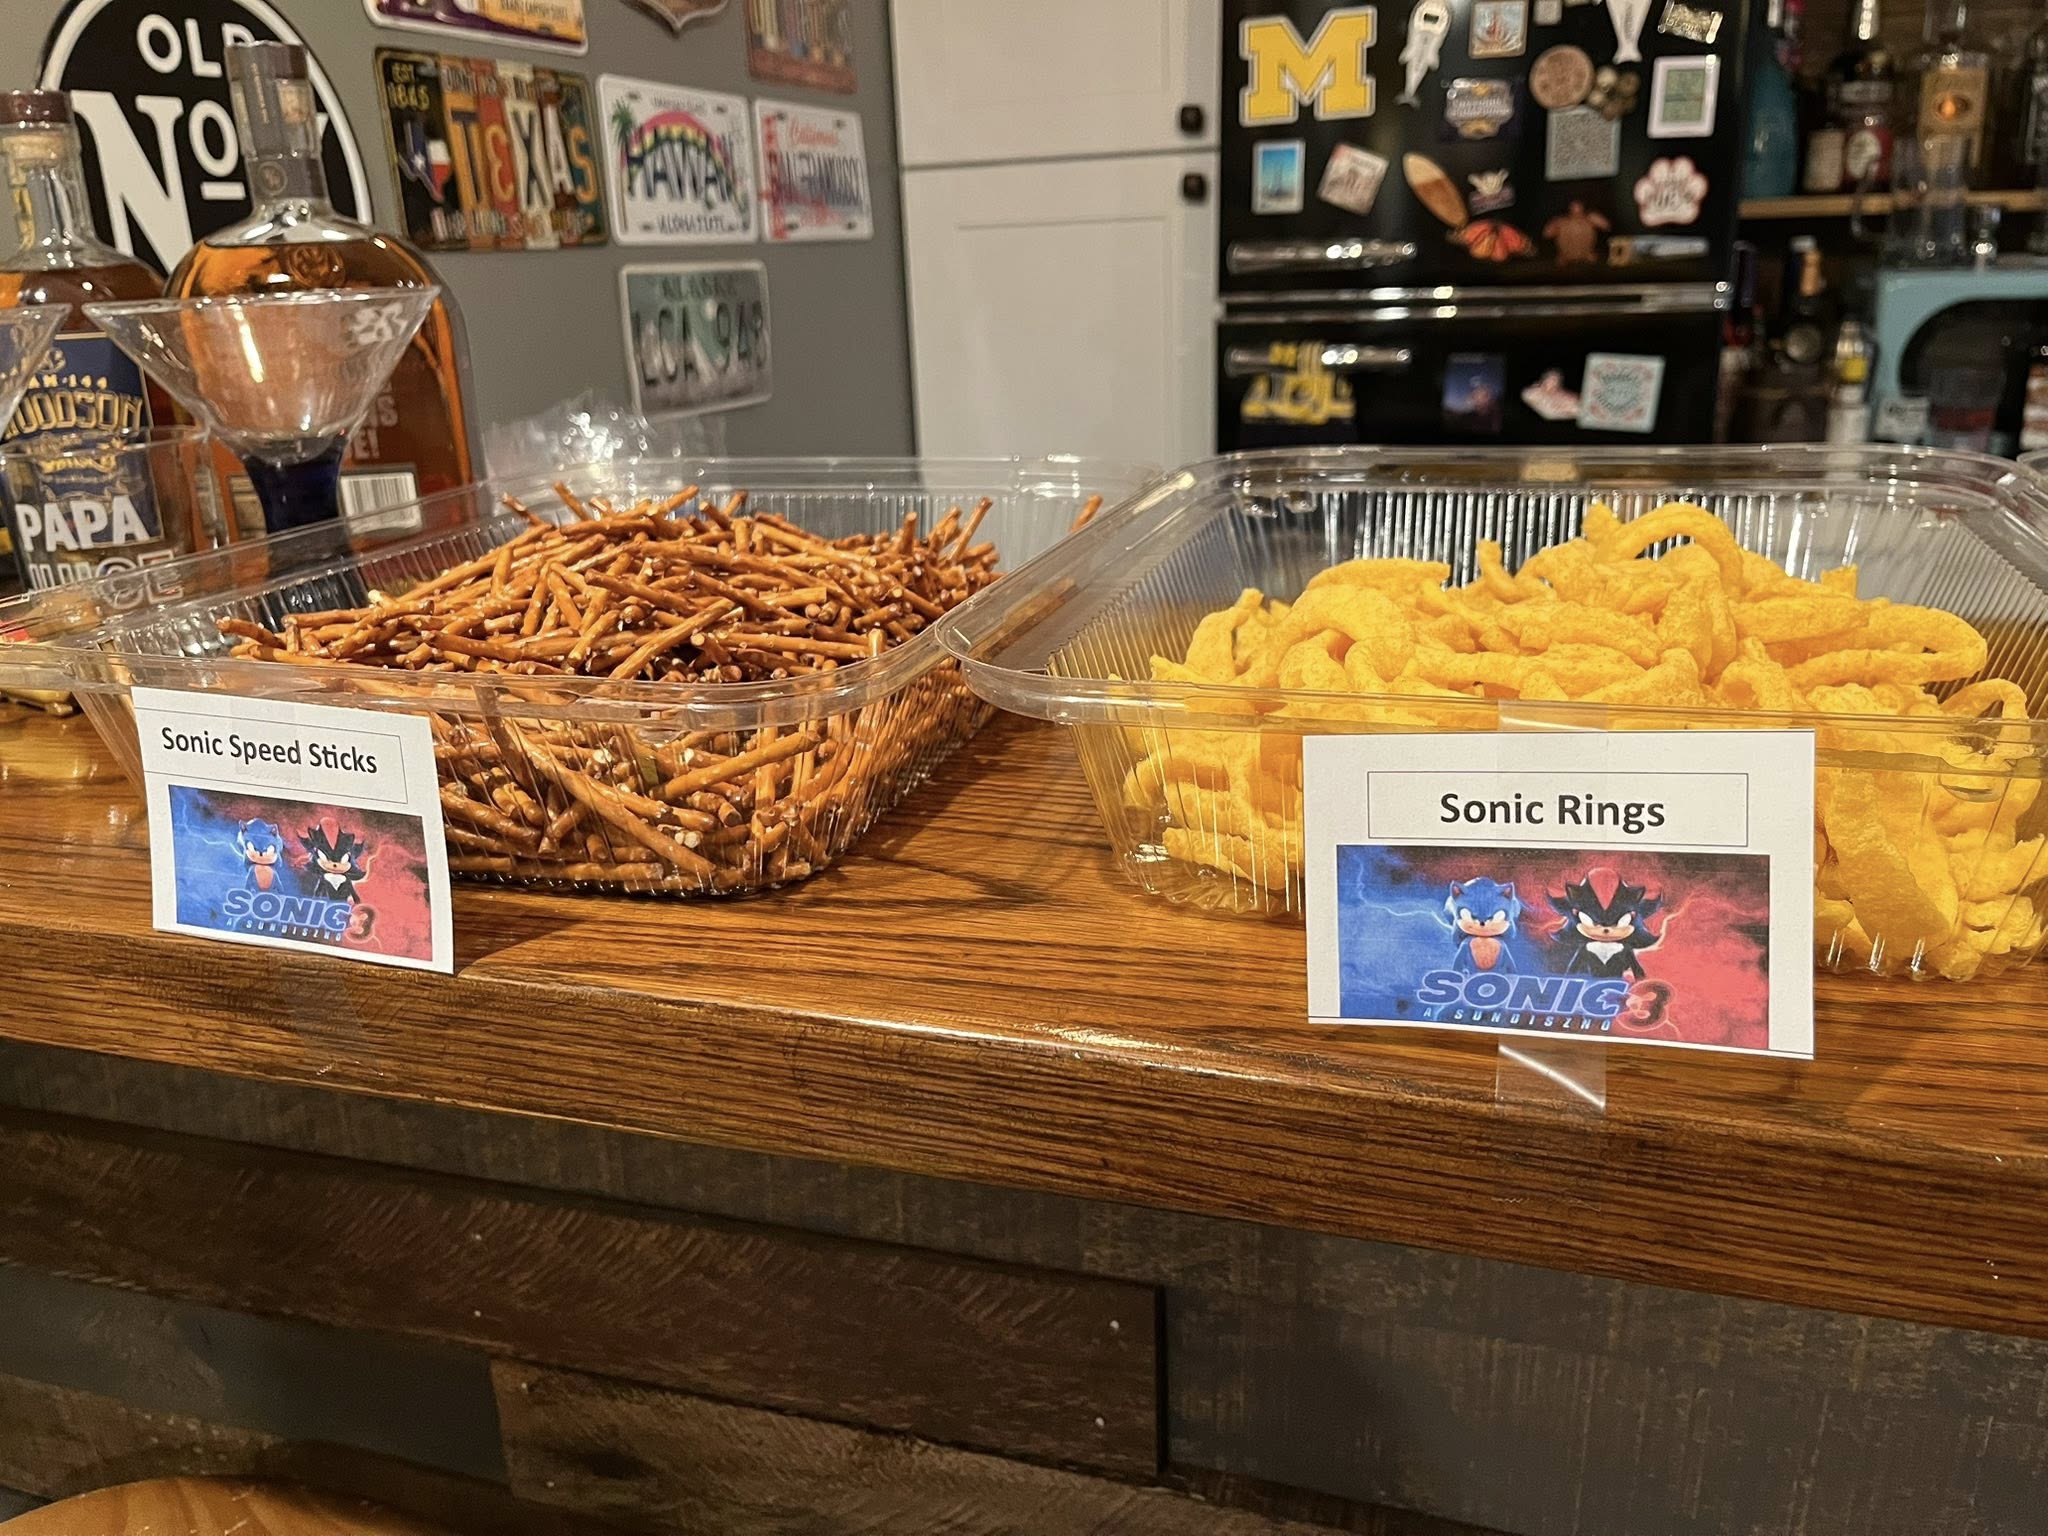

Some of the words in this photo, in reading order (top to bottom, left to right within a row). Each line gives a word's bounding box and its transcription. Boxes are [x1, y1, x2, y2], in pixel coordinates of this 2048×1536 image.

[1241, 7, 1376, 126] M
[450, 107, 598, 207] TEXAS
[5, 387, 143, 440] UDSON
[15, 495, 150, 552] PAPA
[161, 727, 223, 756] Sonic
[229, 734, 301, 766] Speed
[309, 743, 378, 774] Sticks
[1440, 793, 1544, 827] Sonic
[1558, 794, 1666, 835] Rings
[223, 888, 352, 932] SONIC
[1416, 970, 1630, 1018] SONIC
